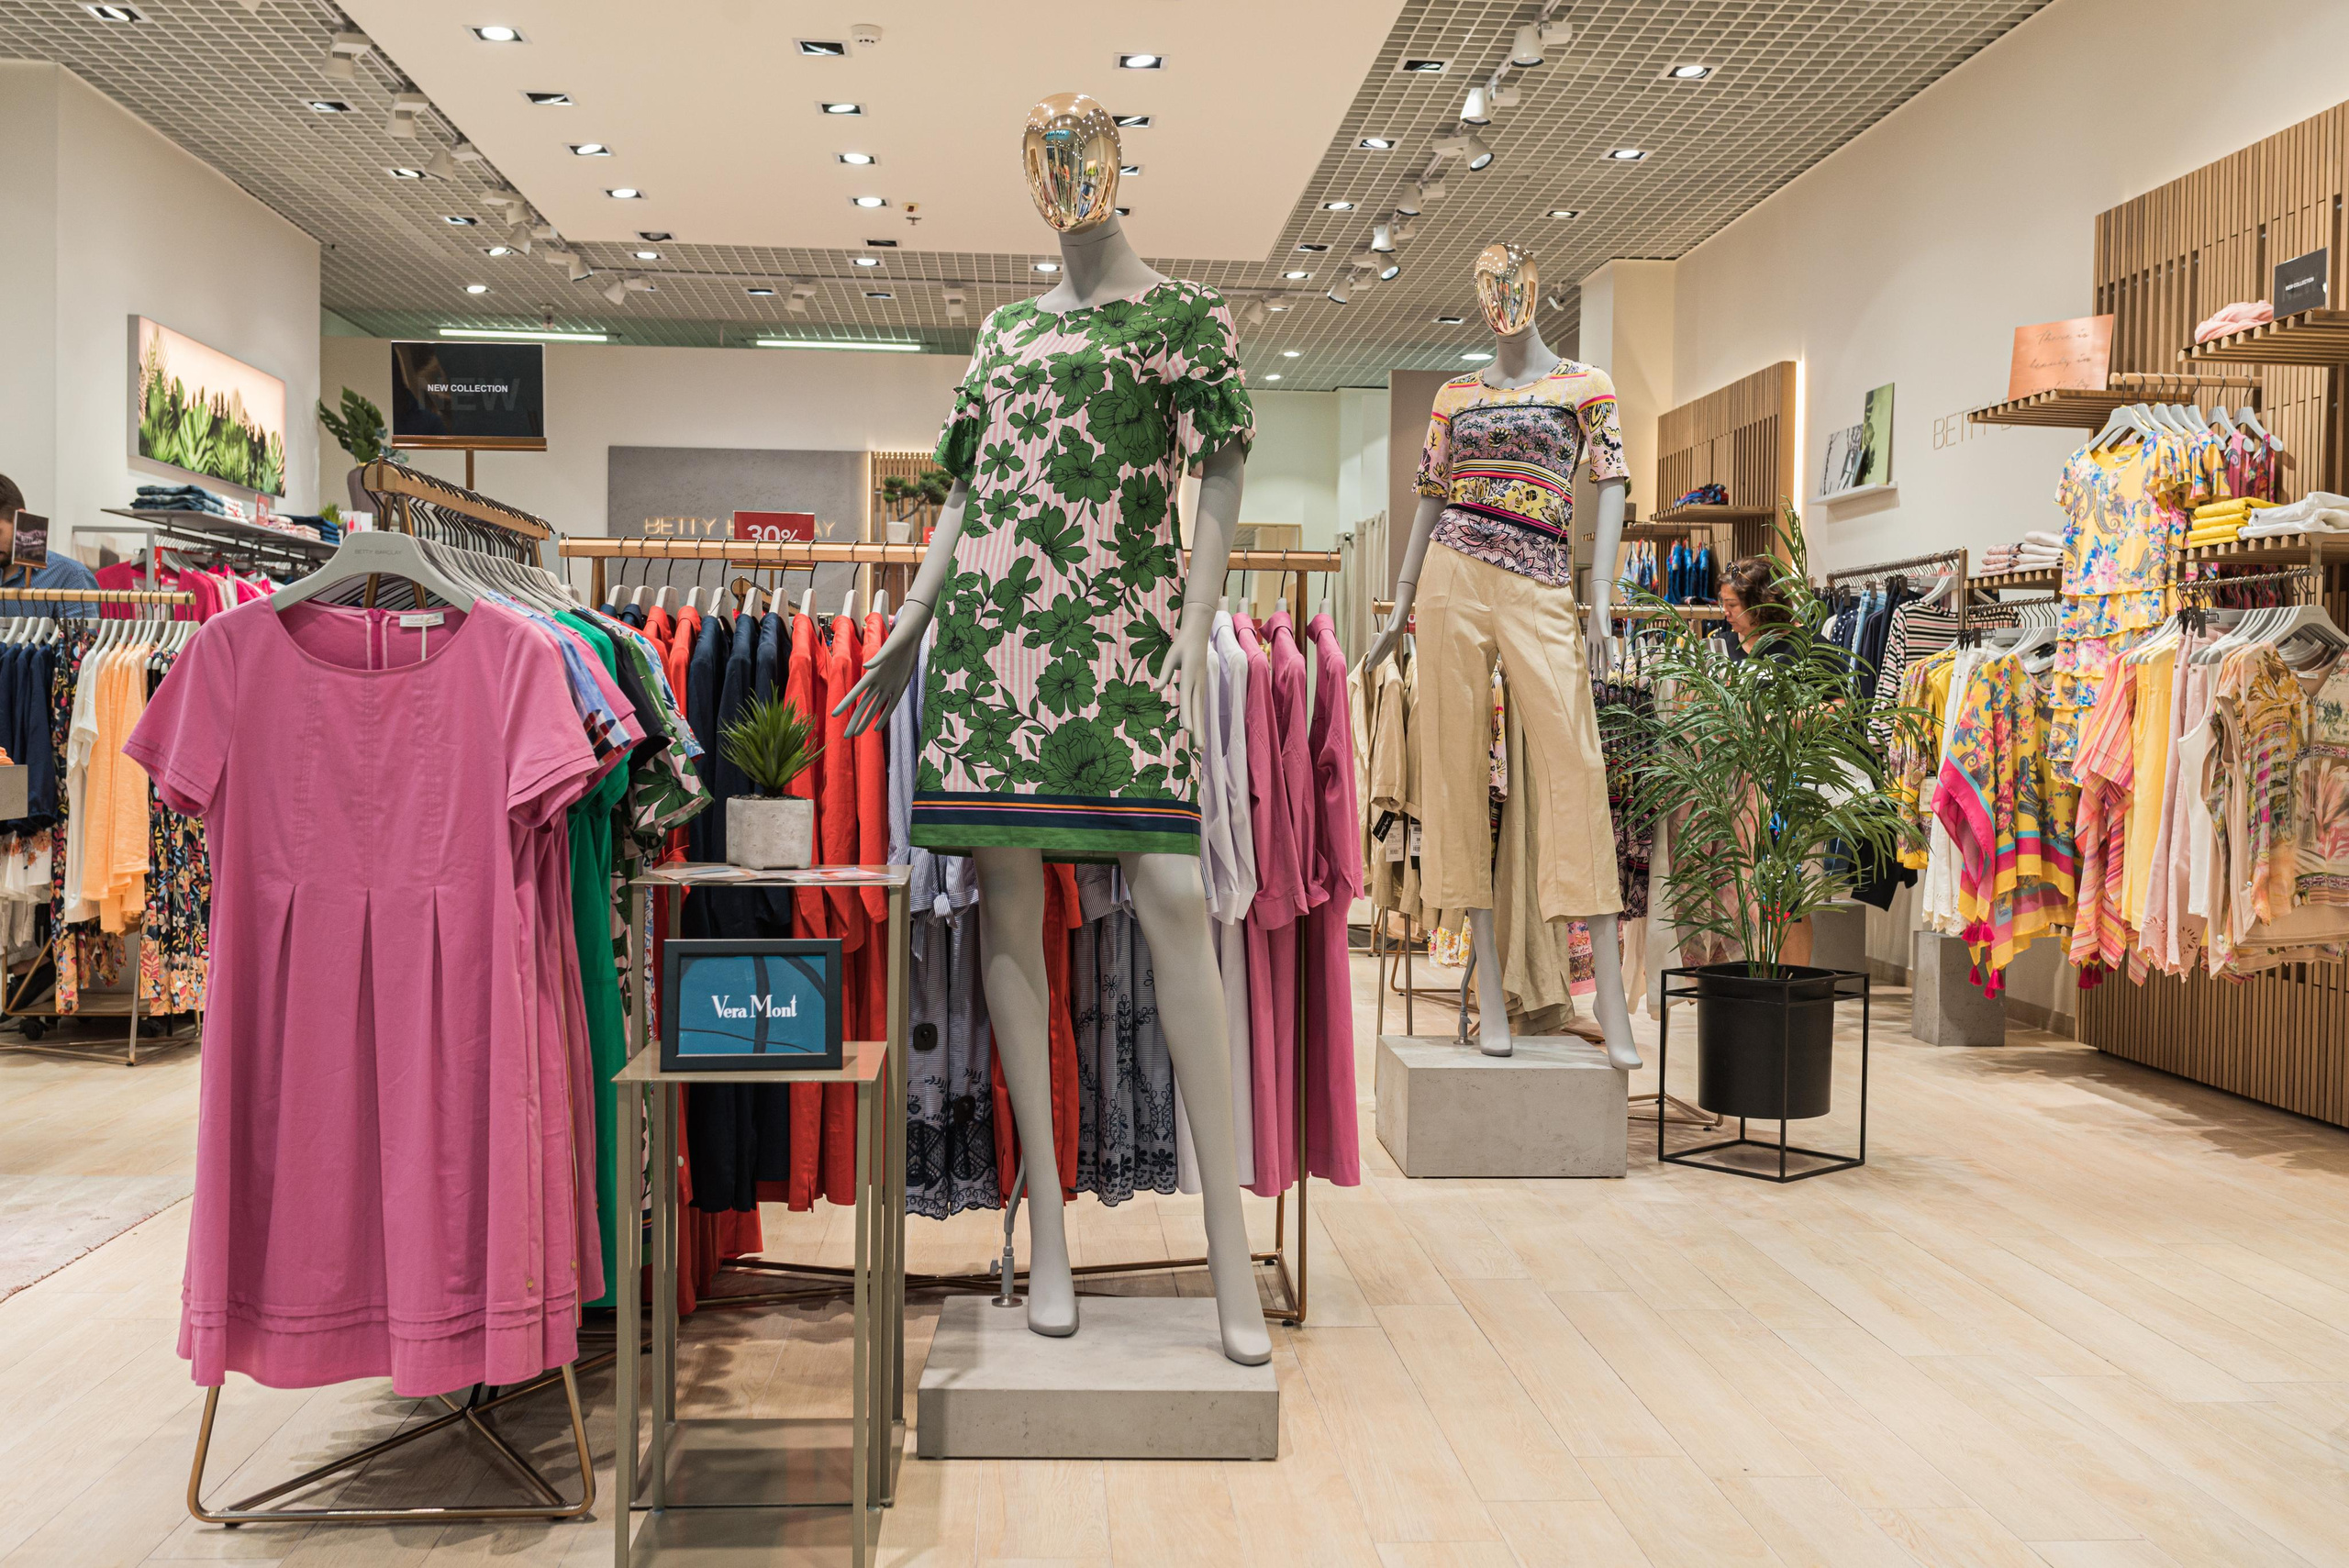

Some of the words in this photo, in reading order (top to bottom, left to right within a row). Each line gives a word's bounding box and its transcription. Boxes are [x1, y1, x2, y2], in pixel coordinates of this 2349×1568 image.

[427, 384, 449, 393] NEW
[450, 384, 508, 394] COLLECTION
[644, 517, 717, 536] BETTY
[711, 995, 748, 1018] Vera
[749, 994, 798, 1018] Mont
